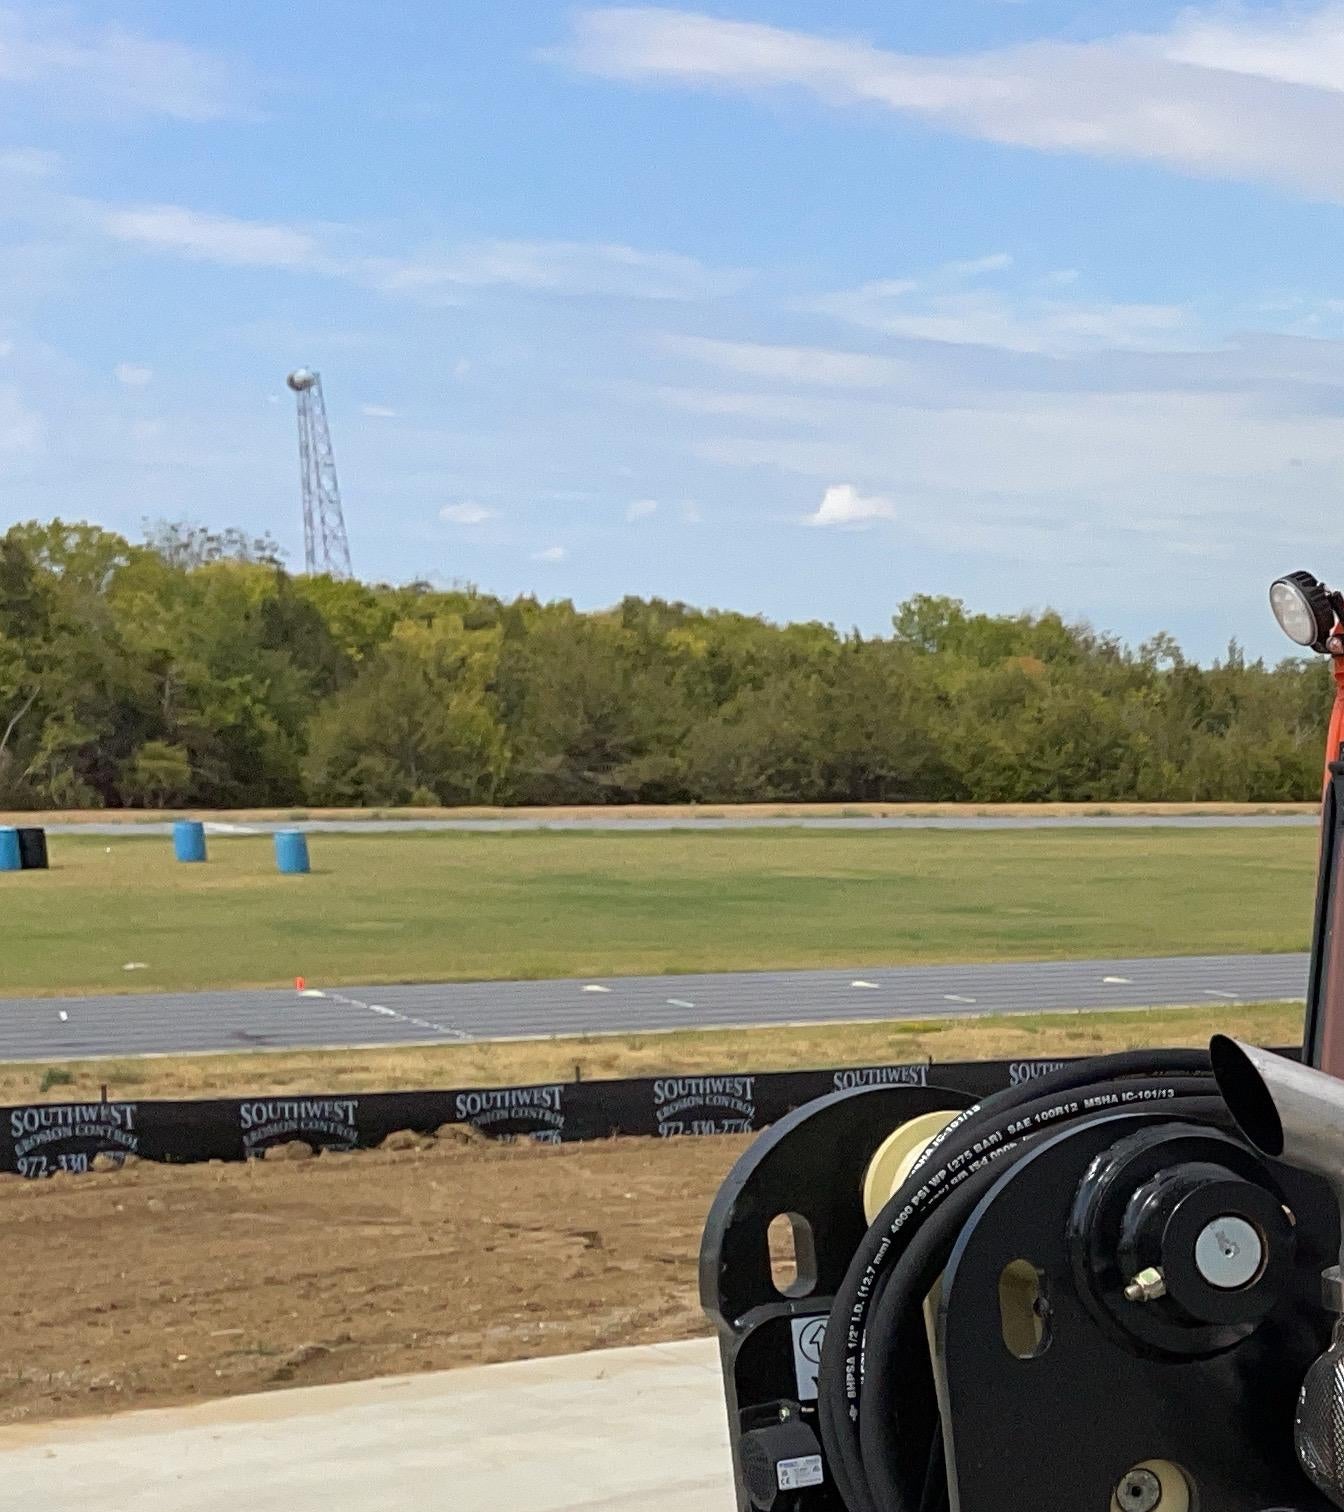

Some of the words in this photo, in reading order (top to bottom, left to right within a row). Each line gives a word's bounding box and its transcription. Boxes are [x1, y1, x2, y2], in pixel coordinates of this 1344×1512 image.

[653, 1076, 756, 1105] SOUTHWEST
[833, 1064, 930, 1092] SOUTHWEST
[240, 1100, 359, 1129] SOUTHWEST
[455, 1085, 565, 1120] SOUTHWEST
[10, 1104, 138, 1138] SOUTHWEST
[890, 1204, 914, 1234] 4000
[911, 1185, 931, 1207] PSI
[928, 1168, 947, 1188] WP
[946, 1150, 973, 1173] (275
[973, 1130, 1003, 1154] BAR)
[1007, 1117, 1033, 1135] SAE
[1034, 1102, 1079, 1124] 100R12
[1084, 1094, 1119, 1109] MSHA
[1122, 1088, 1175, 1102] IC-101/13
